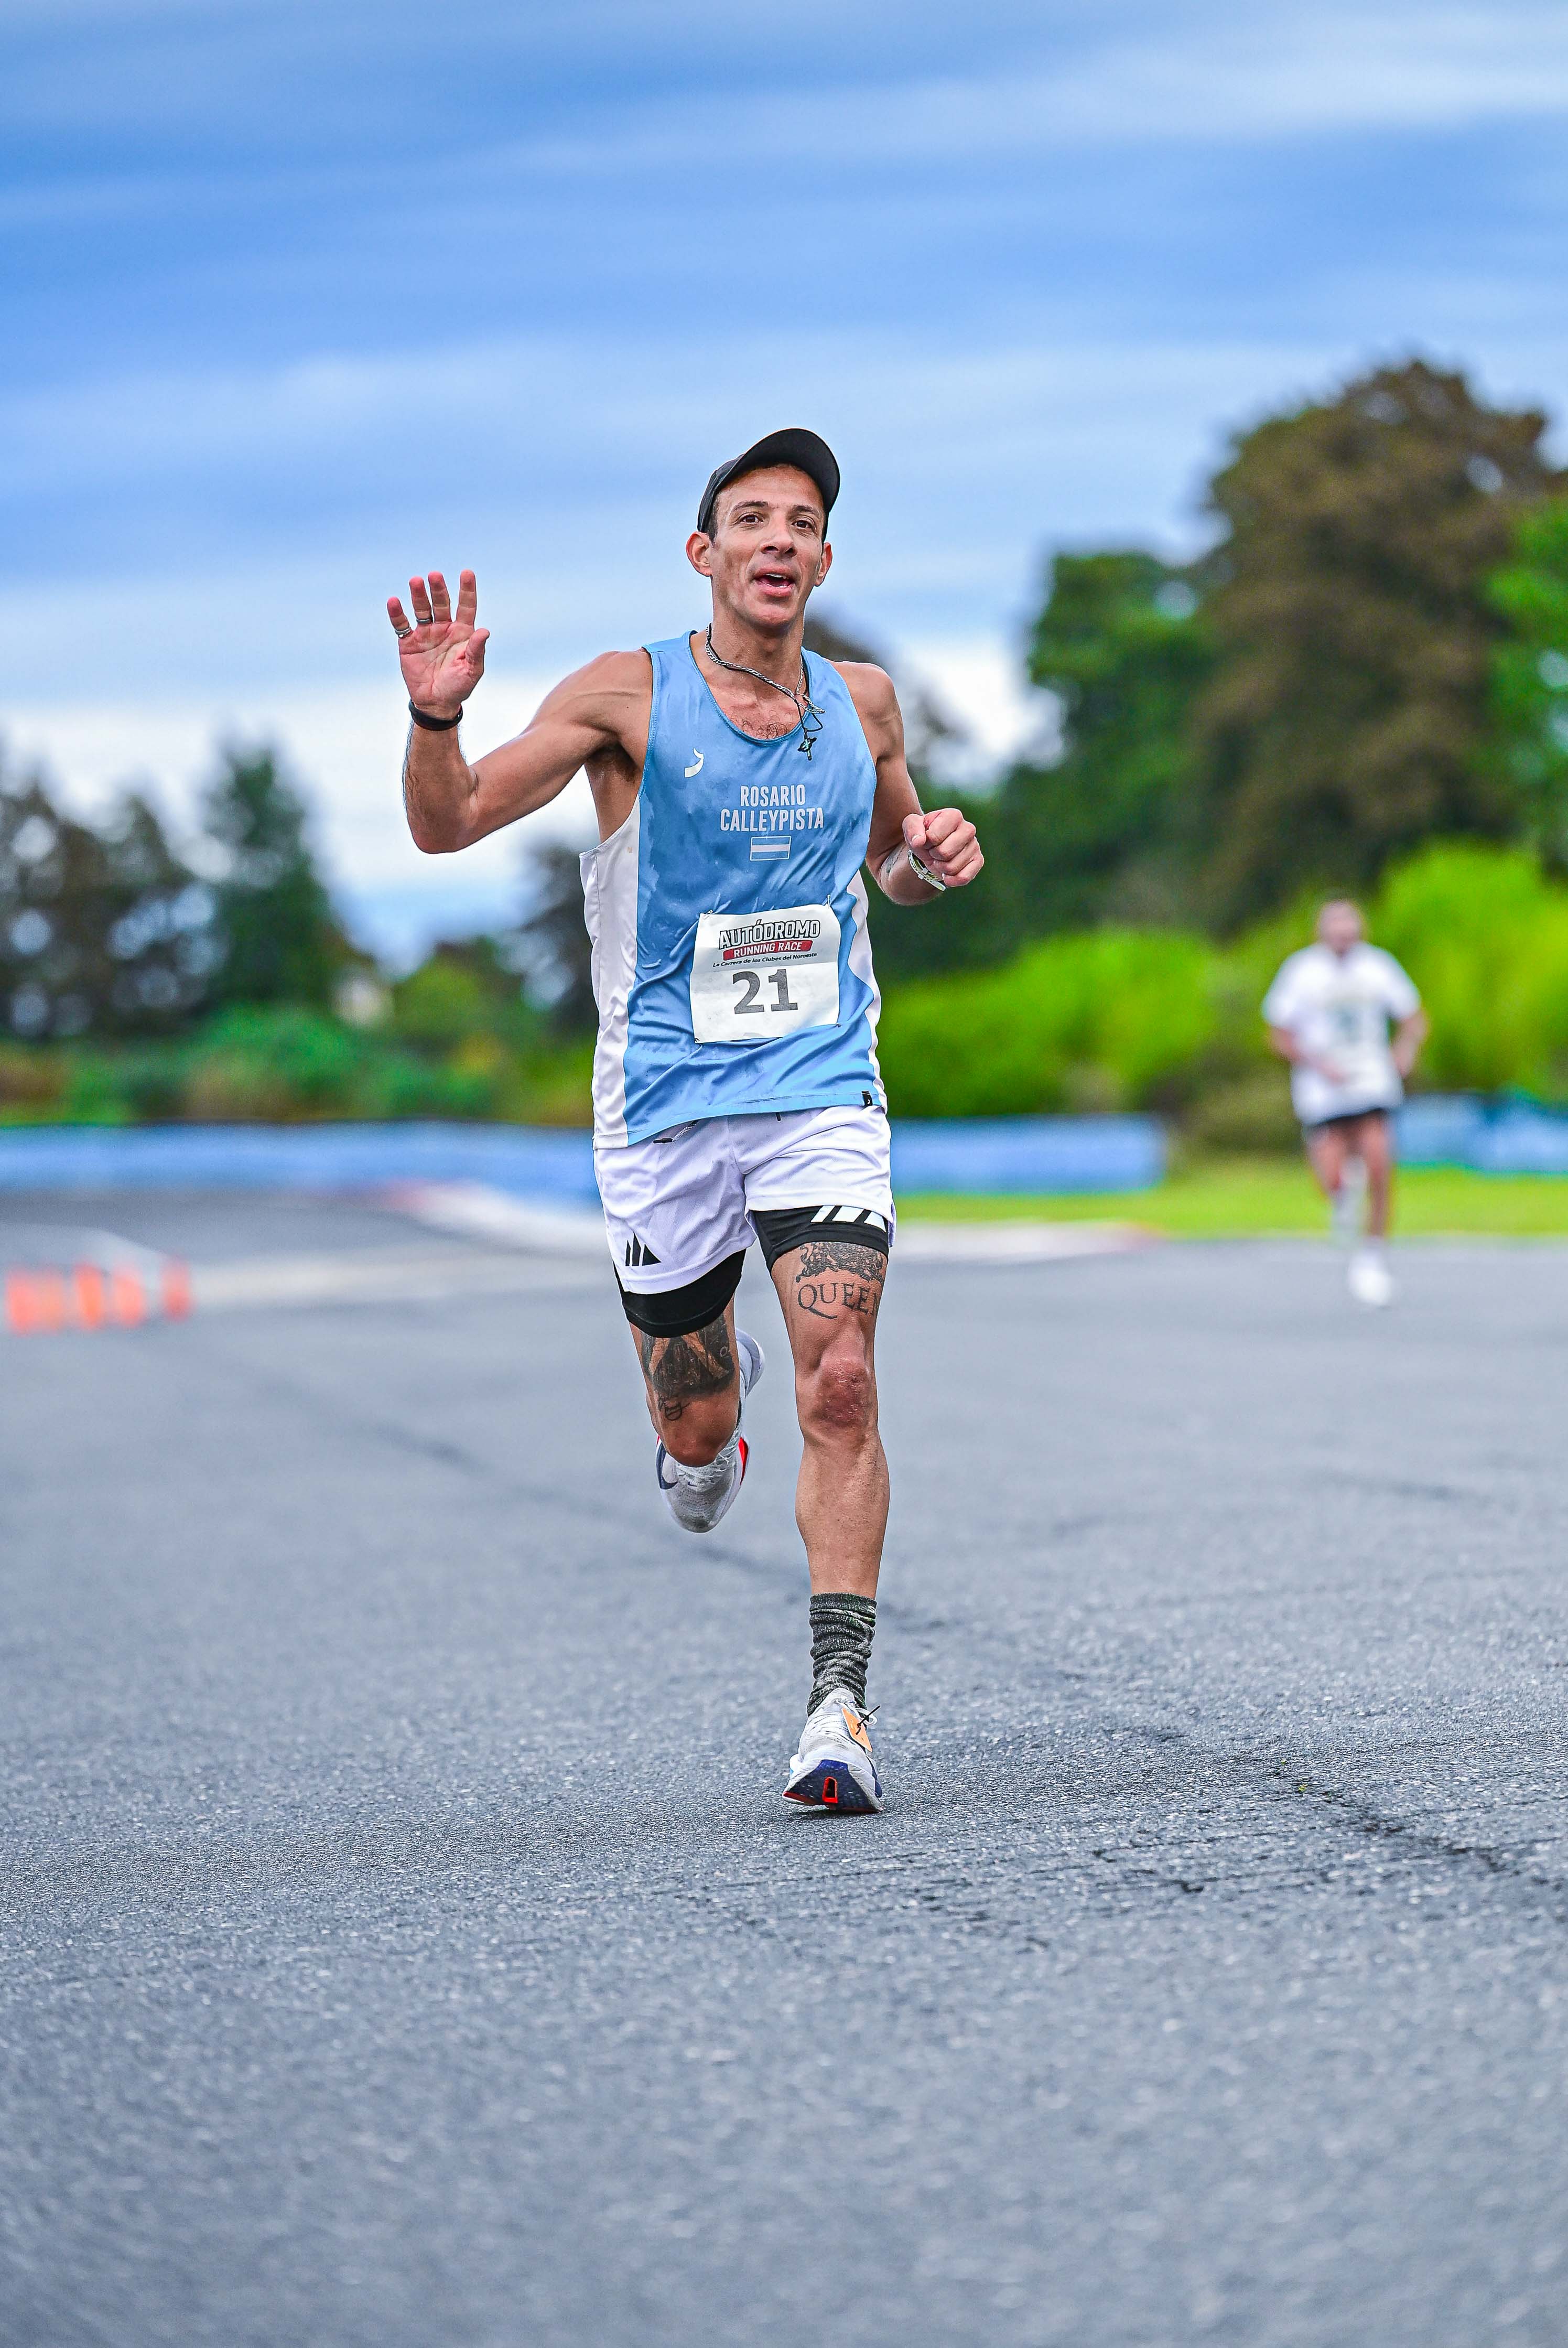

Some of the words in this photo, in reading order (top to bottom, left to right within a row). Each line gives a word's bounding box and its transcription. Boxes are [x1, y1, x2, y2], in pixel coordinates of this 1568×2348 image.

[740, 784, 805, 807] ROSARIO
[720, 807, 824, 832] CALLEYPISTA
[718, 919, 820, 950] AUTÓDROMO
[733, 945, 775, 958] RUNNING
[778, 942, 803, 951] RACE
[732, 968, 798, 1014] 21
